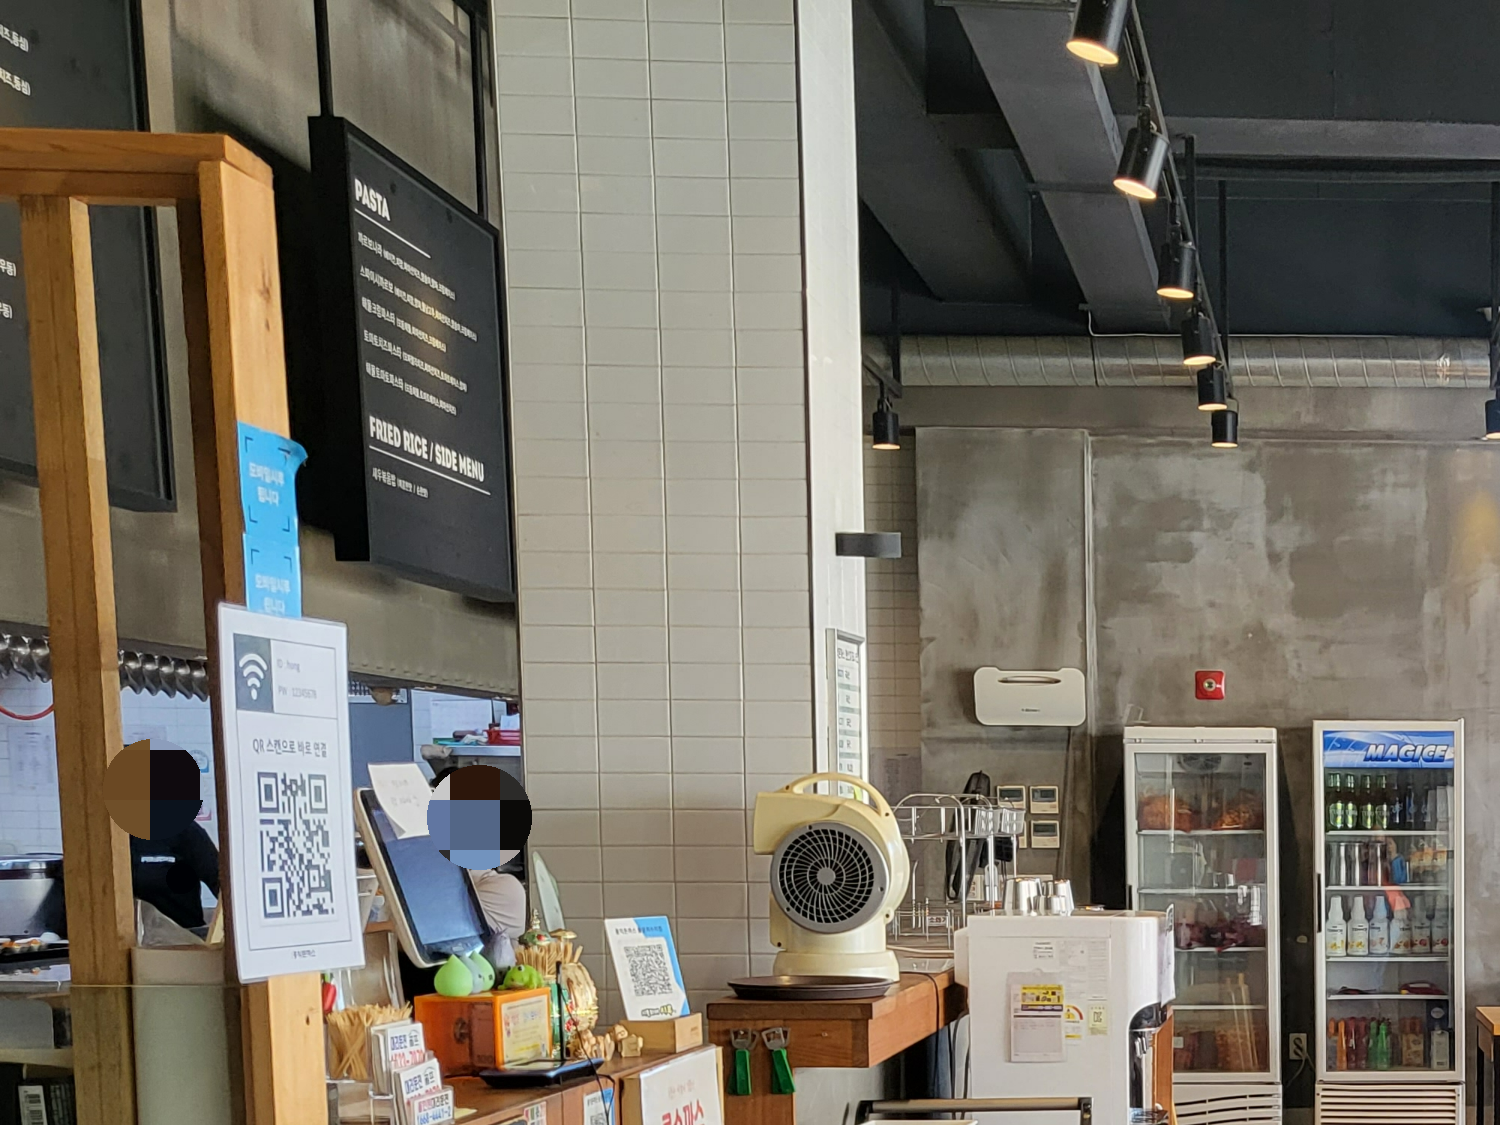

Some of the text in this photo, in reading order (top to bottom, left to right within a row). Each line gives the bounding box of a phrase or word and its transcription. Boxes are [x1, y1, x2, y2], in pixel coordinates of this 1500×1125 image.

[355, 178, 391, 221] PASTA
[369, 415, 401, 448] FRIED
[403, 429, 428, 460] RICE
[435, 443, 458, 472] SIDE
[459, 453, 484, 482] MENU
[253, 739, 327, 758] QR 스캔으로 바로 연결
[1363, 744, 1450, 762] MAGICE
